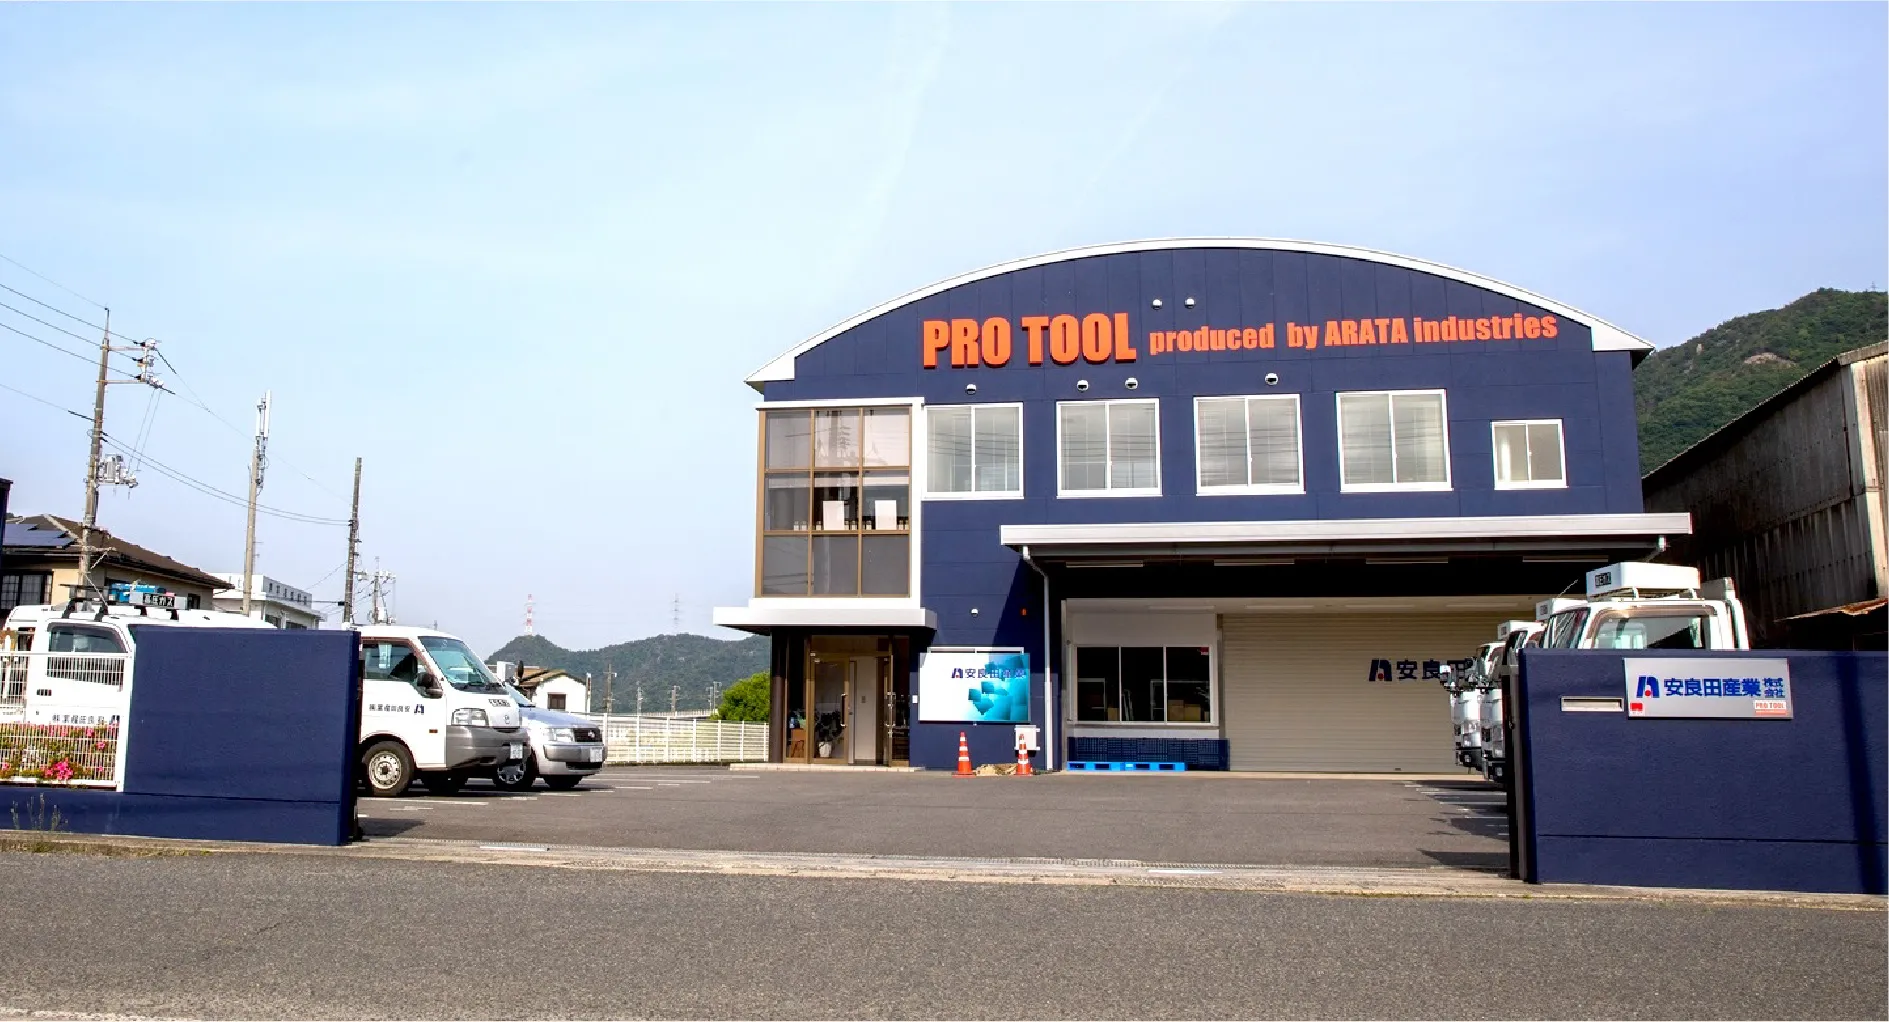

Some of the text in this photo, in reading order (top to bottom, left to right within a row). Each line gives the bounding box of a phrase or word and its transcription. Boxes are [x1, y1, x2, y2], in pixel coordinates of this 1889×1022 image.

[923, 312, 1558, 370] PRO TOOL produced by ARATA industries
[1663, 677, 1761, 697] 安良田産業
